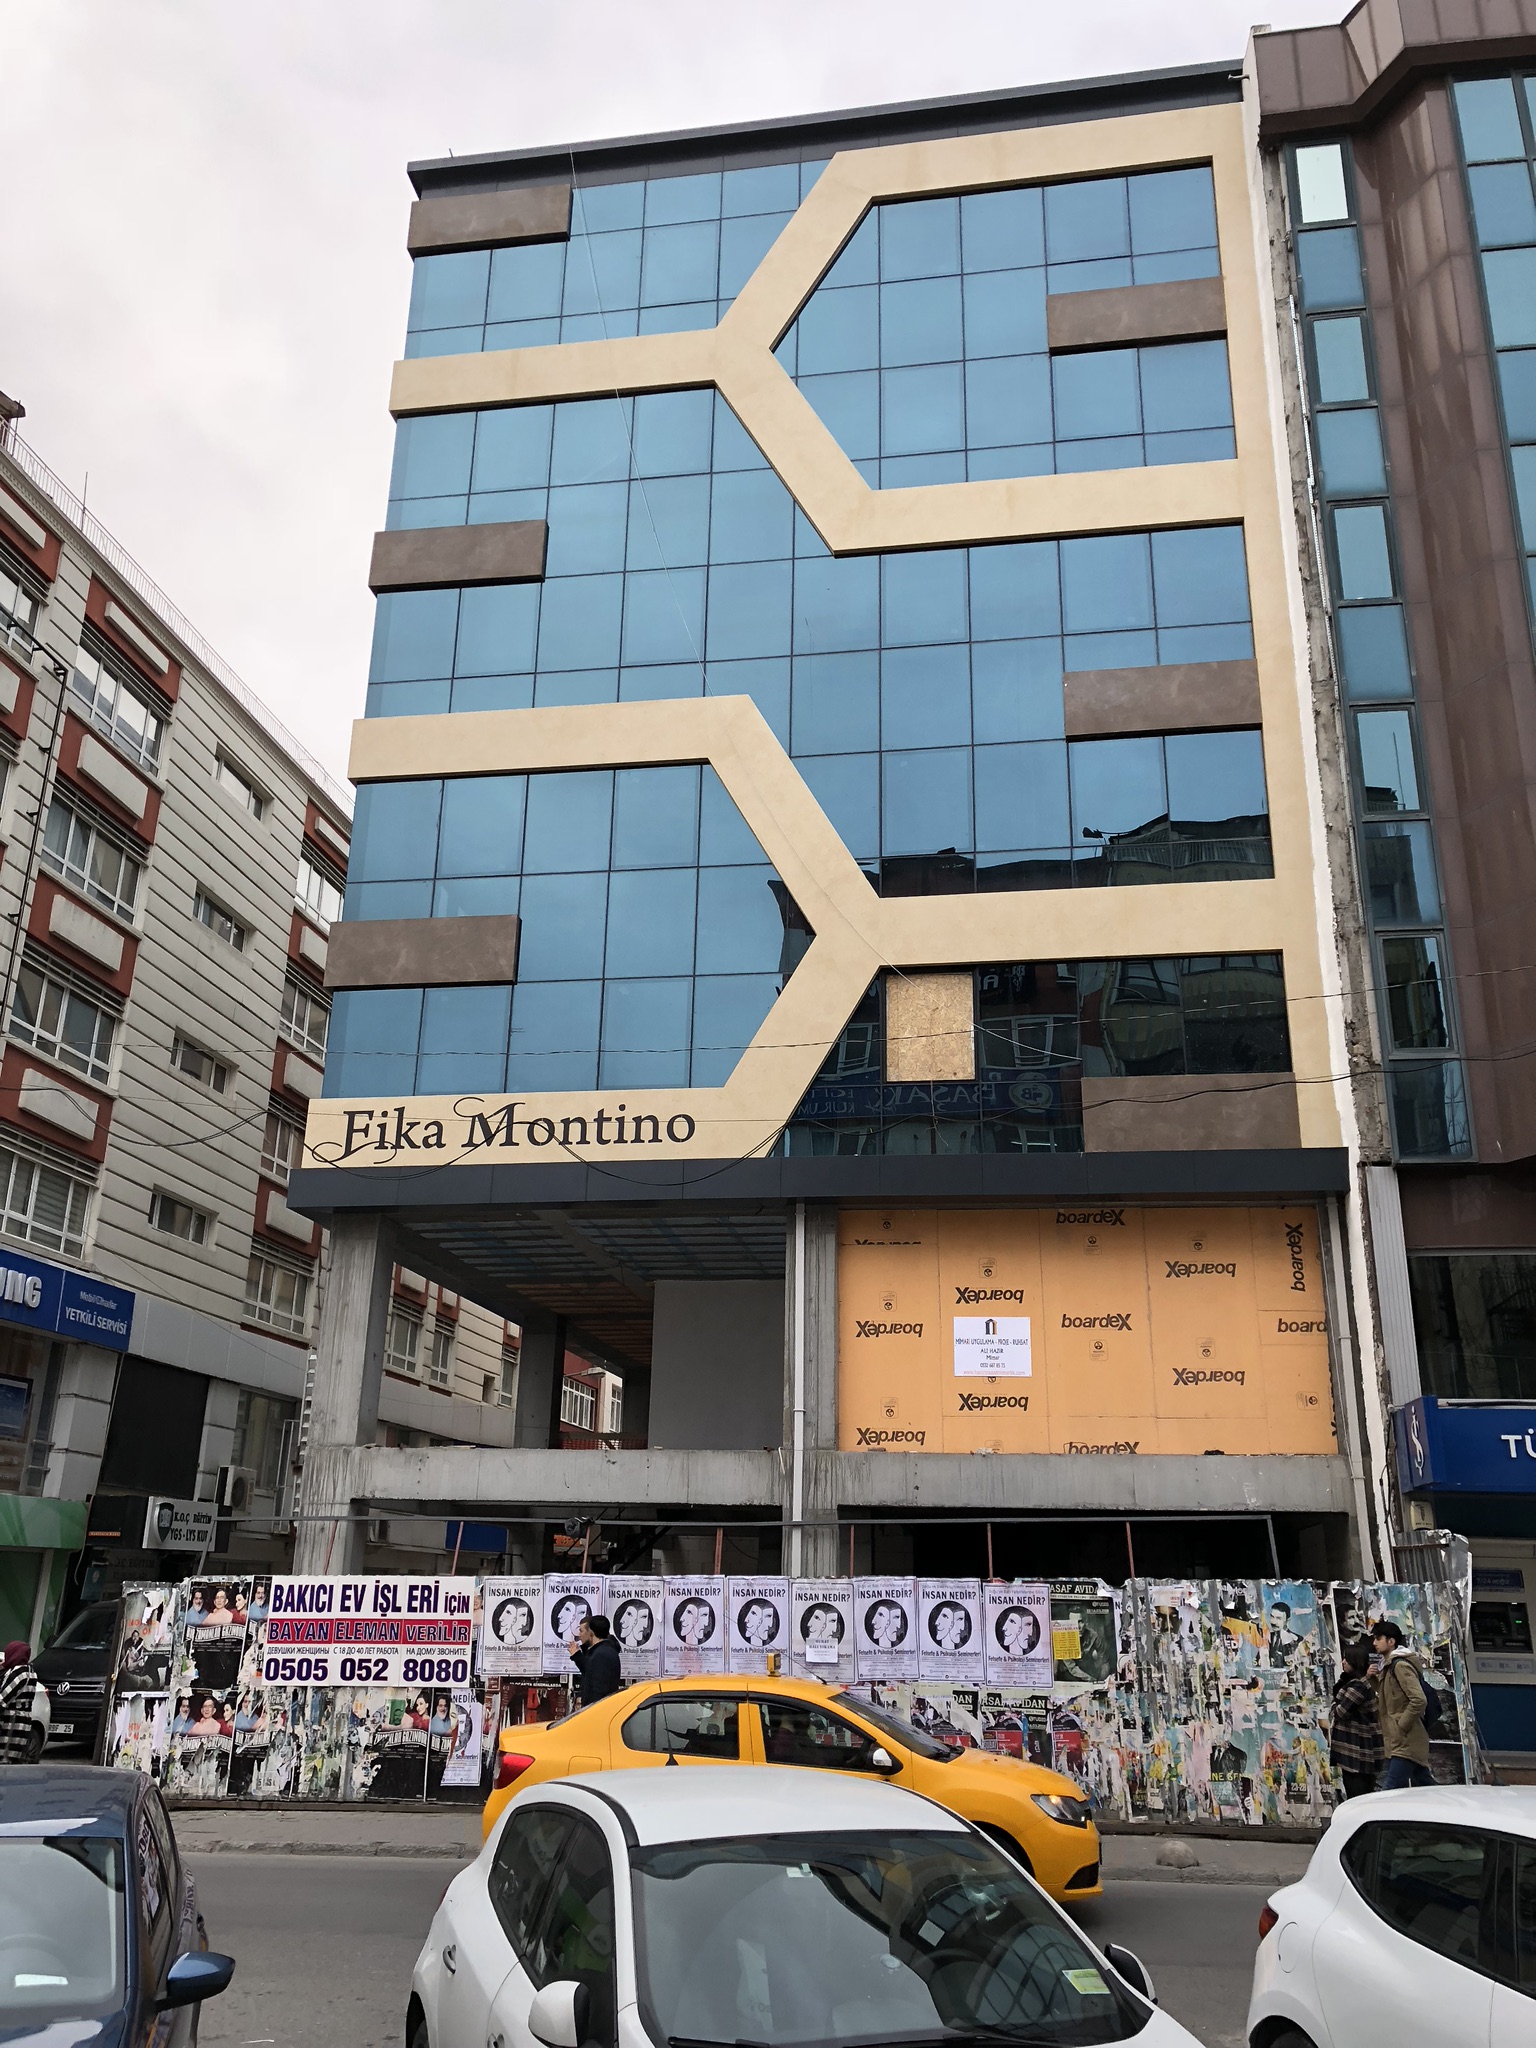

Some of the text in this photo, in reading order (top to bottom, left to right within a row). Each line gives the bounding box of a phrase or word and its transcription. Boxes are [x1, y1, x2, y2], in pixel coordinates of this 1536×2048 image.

[311, 1096, 696, 1164] Fika Montino
[1056, 1209, 1126, 1226] boardeX
[1284, 1223, 1306, 1292] boardeX
[1165, 1260, 1236, 1278] boardeX
[955, 1287, 1024, 1304] boardeX
[65, 1306, 128, 1335] YETKİLİ SERVİSİ
[855, 1320, 923, 1338] boardeX
[1061, 1313, 1132, 1331] boardeX
[1172, 1367, 1246, 1386] boardeX
[958, 1393, 1029, 1411] boardeX
[856, 1427, 926, 1446] boardeX
[170, 1528, 182, 1541] YGS
[271, 1583, 334, 1613] BAKICI
[340, 1583, 366, 1613] EV
[489, 1586, 541, 1597] İNSAN NEDİR?
[549, 1584, 600, 1595] İNSAN NEDİR?
[608, 1588, 661, 1599] İNSAN NEDİR?
[668, 1586, 721, 1596] İNSAN NEDİR?
[732, 1587, 757, 1597] İNSAN
[758, 1589, 786, 1598] NEDİR?
[795, 1591, 851, 1603] İNSAN NEDİR?
[858, 1588, 913, 1599] İNSAN NEDİR?
[922, 1589, 977, 1600] İNSAN NEDİR?
[989, 1595, 1014, 1605] İNSAN
[1016, 1596, 1046, 1606] NEDİR?
[268, 1621, 469, 1643] BAYAN ELEMAN VERİLİR
[267, 1647, 296, 1655] ДЕВУШКИ
[296, 1647, 329, 1655] ЖЕНЩИНЫ
[339, 1647, 345, 1655] 18
[346, 1647, 355, 1655] ДО
[356, 1647, 364, 1655] 40
[364, 1647, 376, 1655] ЛЕТ
[377, 1647, 399, 1655] РАБОТА
[416, 1648, 436, 1656] ДОМУ
[265, 1658, 328, 1682] 0505
[340, 1658, 389, 1682] 052
[403, 1658, 468, 1683] 8080
